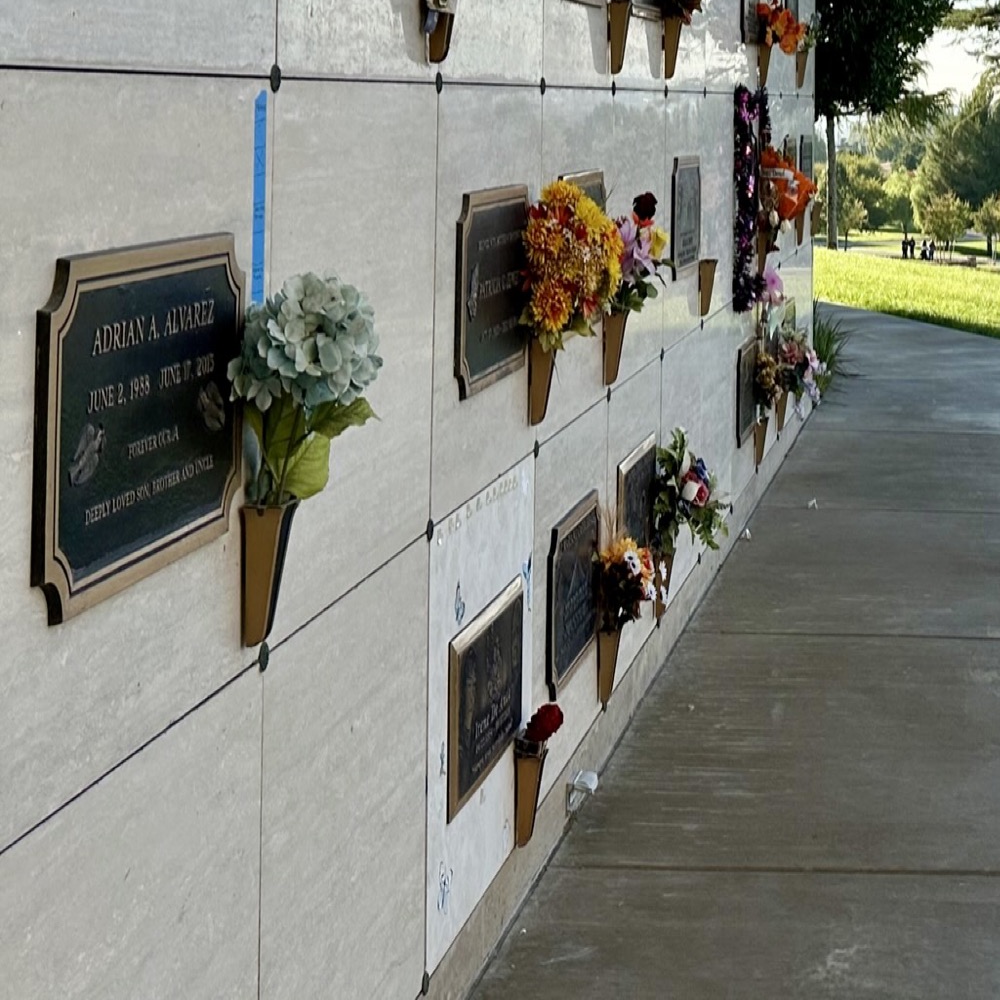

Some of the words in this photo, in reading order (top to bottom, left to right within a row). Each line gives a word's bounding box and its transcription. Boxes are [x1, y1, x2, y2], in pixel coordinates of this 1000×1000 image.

[92, 315, 145, 356] ADRIAN
[148, 313, 160, 341] A.
[163, 298, 215, 337] ALVAREZ
[87, 385, 114, 414] JUNE
[117, 383, 127, 405] 2,
[130, 374, 150, 400] 1988
[159, 362, 181, 390] JUNE
[127, 435, 157, 460] FOREVER
[85, 499, 111, 526] DEEPLY
[112, 490, 136, 514] LOVED
[152, 469, 180, 495] BROTHER
[180, 463, 195, 480] AND
[195, 454, 214, 474] UNCLE
